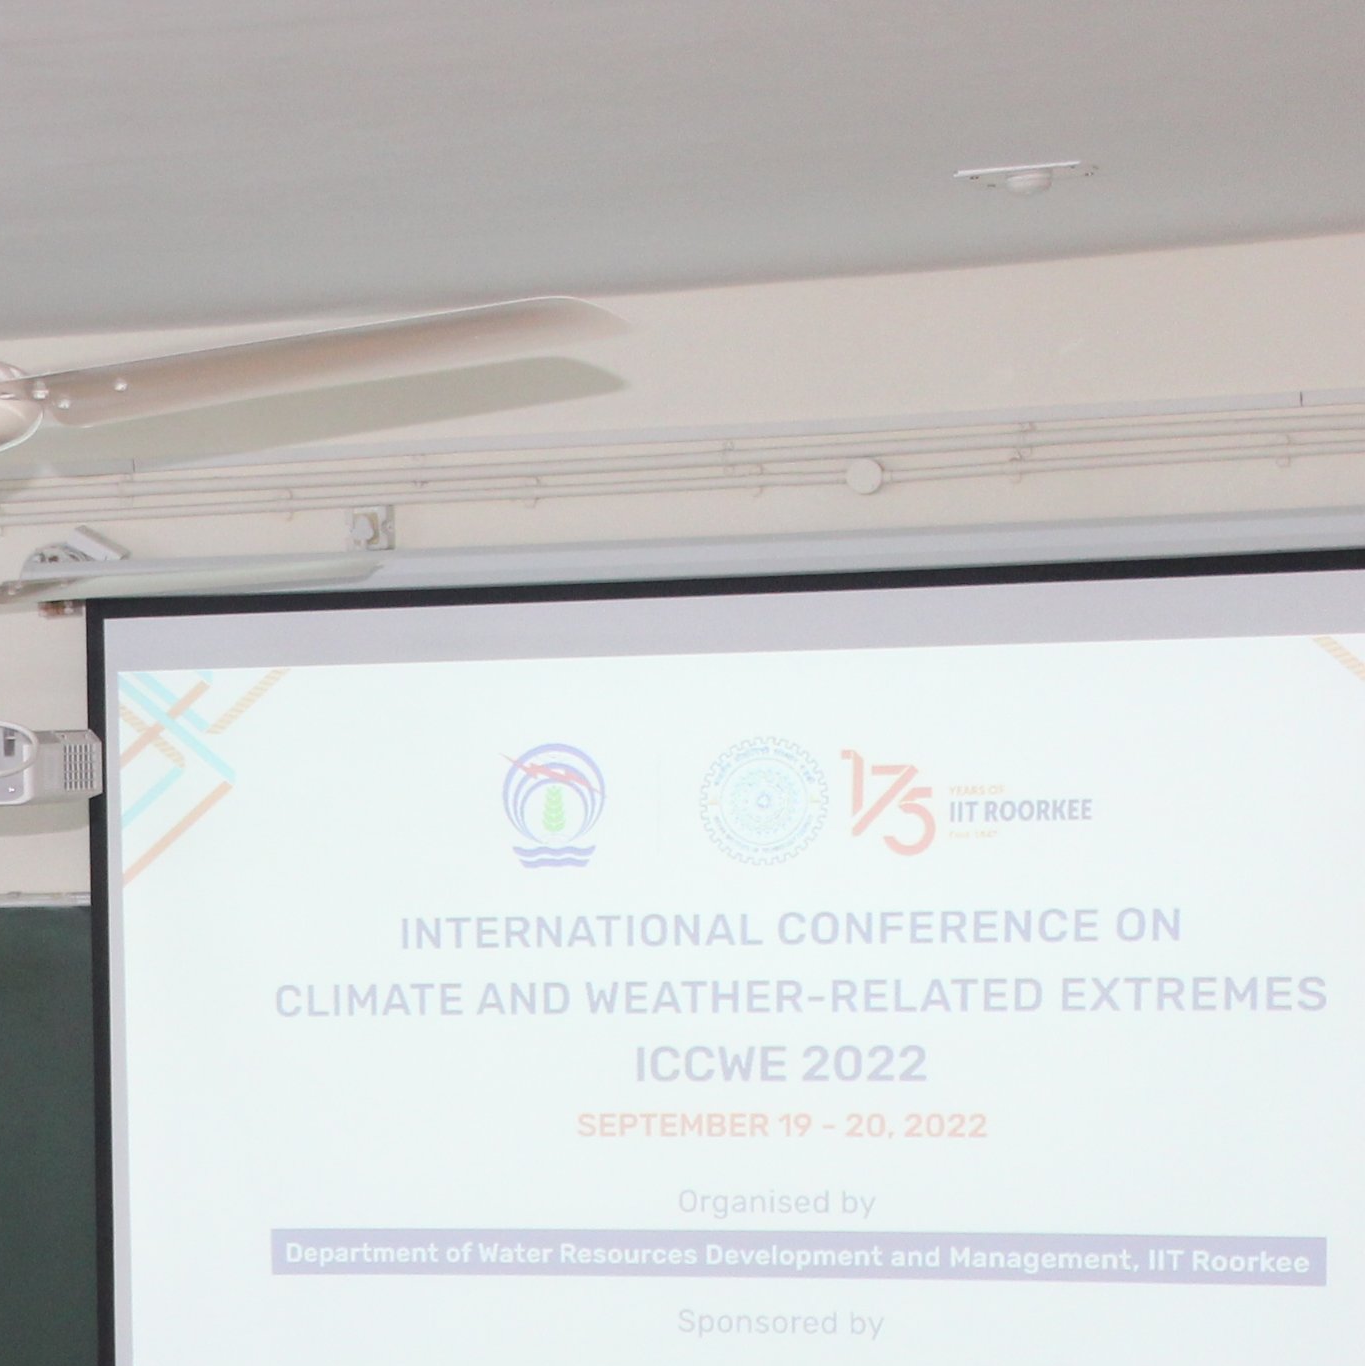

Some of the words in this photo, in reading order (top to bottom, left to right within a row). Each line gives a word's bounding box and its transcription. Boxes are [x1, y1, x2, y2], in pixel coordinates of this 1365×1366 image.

[949, 801, 979, 822] IIT
[984, 799, 1092, 822] ROORKEE
[401, 913, 763, 949] INTERNATIONAL
[778, 908, 1099, 945] CONFERENCE
[1116, 907, 1181, 942] ON
[275, 982, 463, 1018] CLIMATE
[477, 982, 570, 1015] AND
[585, 979, 1043, 1016] WEATHER-RELATED
[1062, 976, 1328, 1012] EXTREMES
[638, 1045, 787, 1083] ICCWE
[803, 1044, 927, 1082] 2022
[577, 1112, 769, 1138] SEPTEMBER
[778, 1112, 812, 1138] 19
[846, 1112, 895, 1141] 20,
[904, 1112, 987, 1138] 2022
[678, 1189, 829, 1219] Organised
[841, 1190, 876, 1219] by
[287, 1242, 438, 1267] Department
[447, 1242, 473, 1263] of
[479, 1243, 554, 1265] Water
[561, 1244, 697, 1265] Resources
[706, 1244, 883, 1272] Development
[892, 1246, 940, 1267] and
[951, 1247, 1139, 1274] Management,
[1150, 1248, 1184, 1271] IIT
[1193, 1248, 1309, 1273] Roorkee
[677, 1308, 838, 1339] Sponsored
[850, 1310, 884, 1339] by
